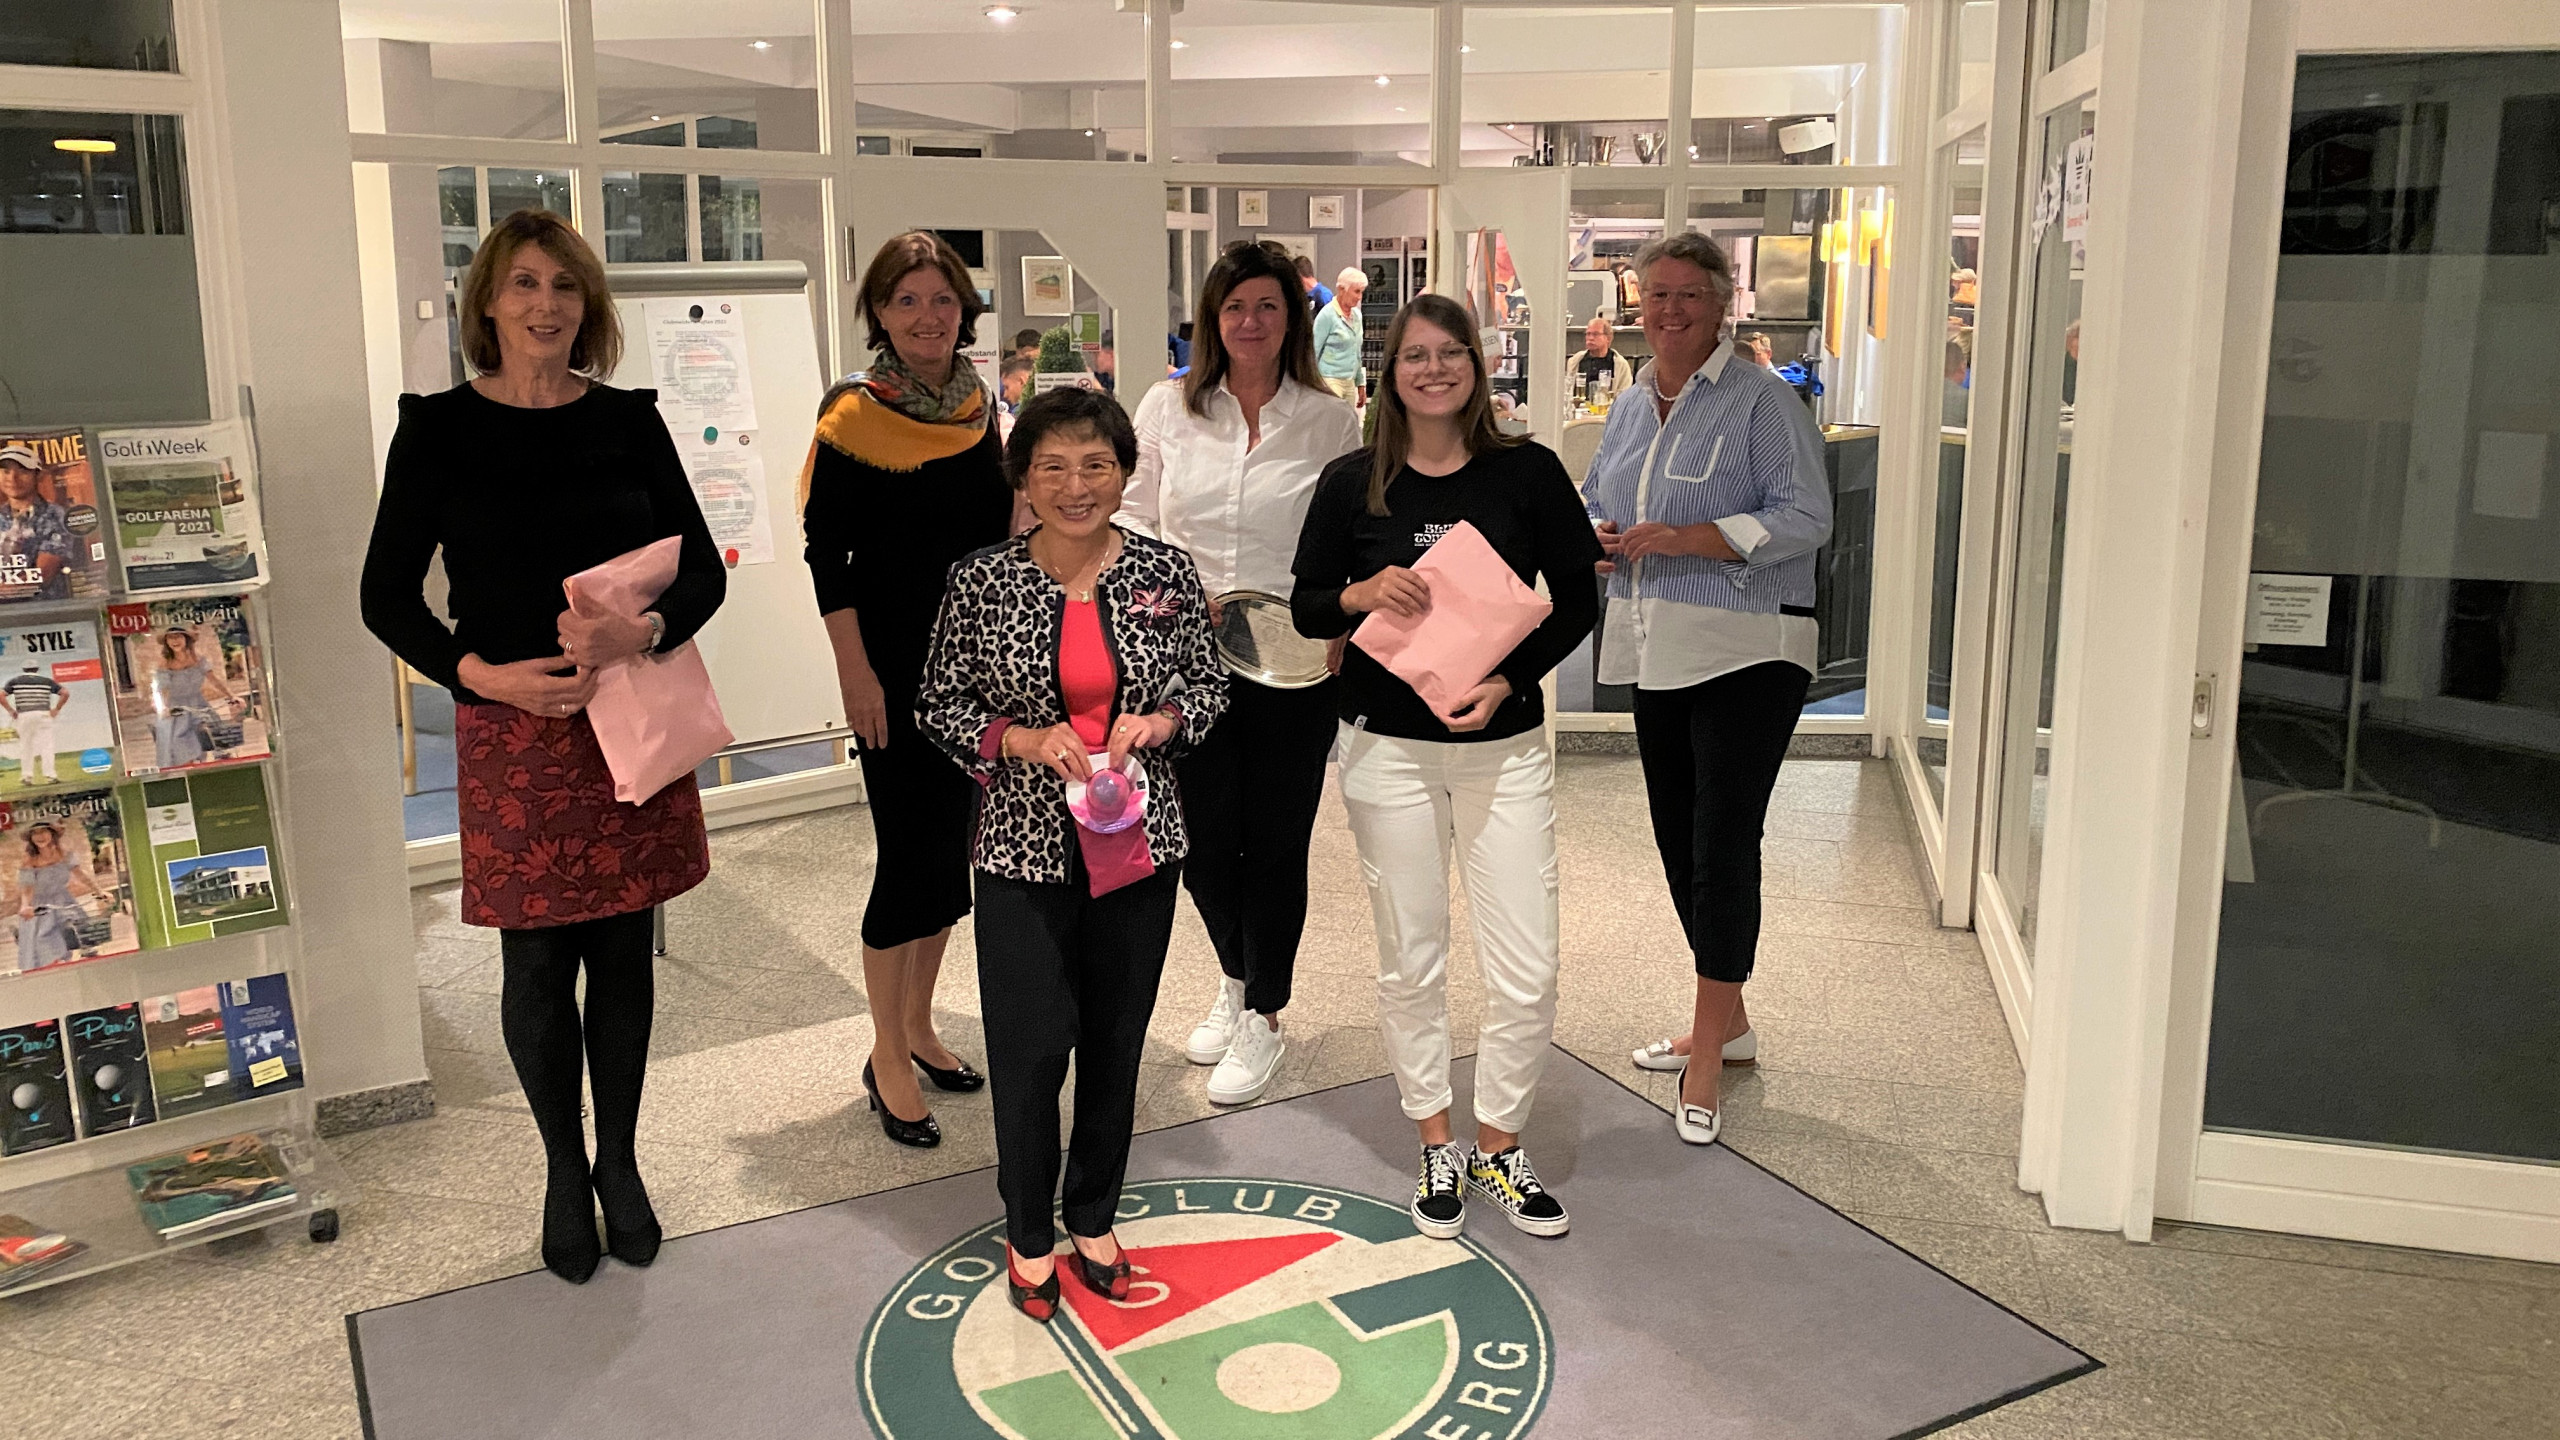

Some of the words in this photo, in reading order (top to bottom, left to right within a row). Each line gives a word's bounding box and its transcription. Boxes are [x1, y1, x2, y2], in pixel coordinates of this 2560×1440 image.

[27, 435, 86, 465] TIME
[125, 508, 211, 524] GOLFARENA
[178, 521, 212, 534] 2021
[0, 567, 43, 585] KE
[111, 612, 148, 631] top
[150, 604, 239, 626] magazin
[905, 1233, 1008, 1321] GO
[1115, 1188, 1342, 1222] CLUB
[1423, 1341, 1529, 1440] ERG
